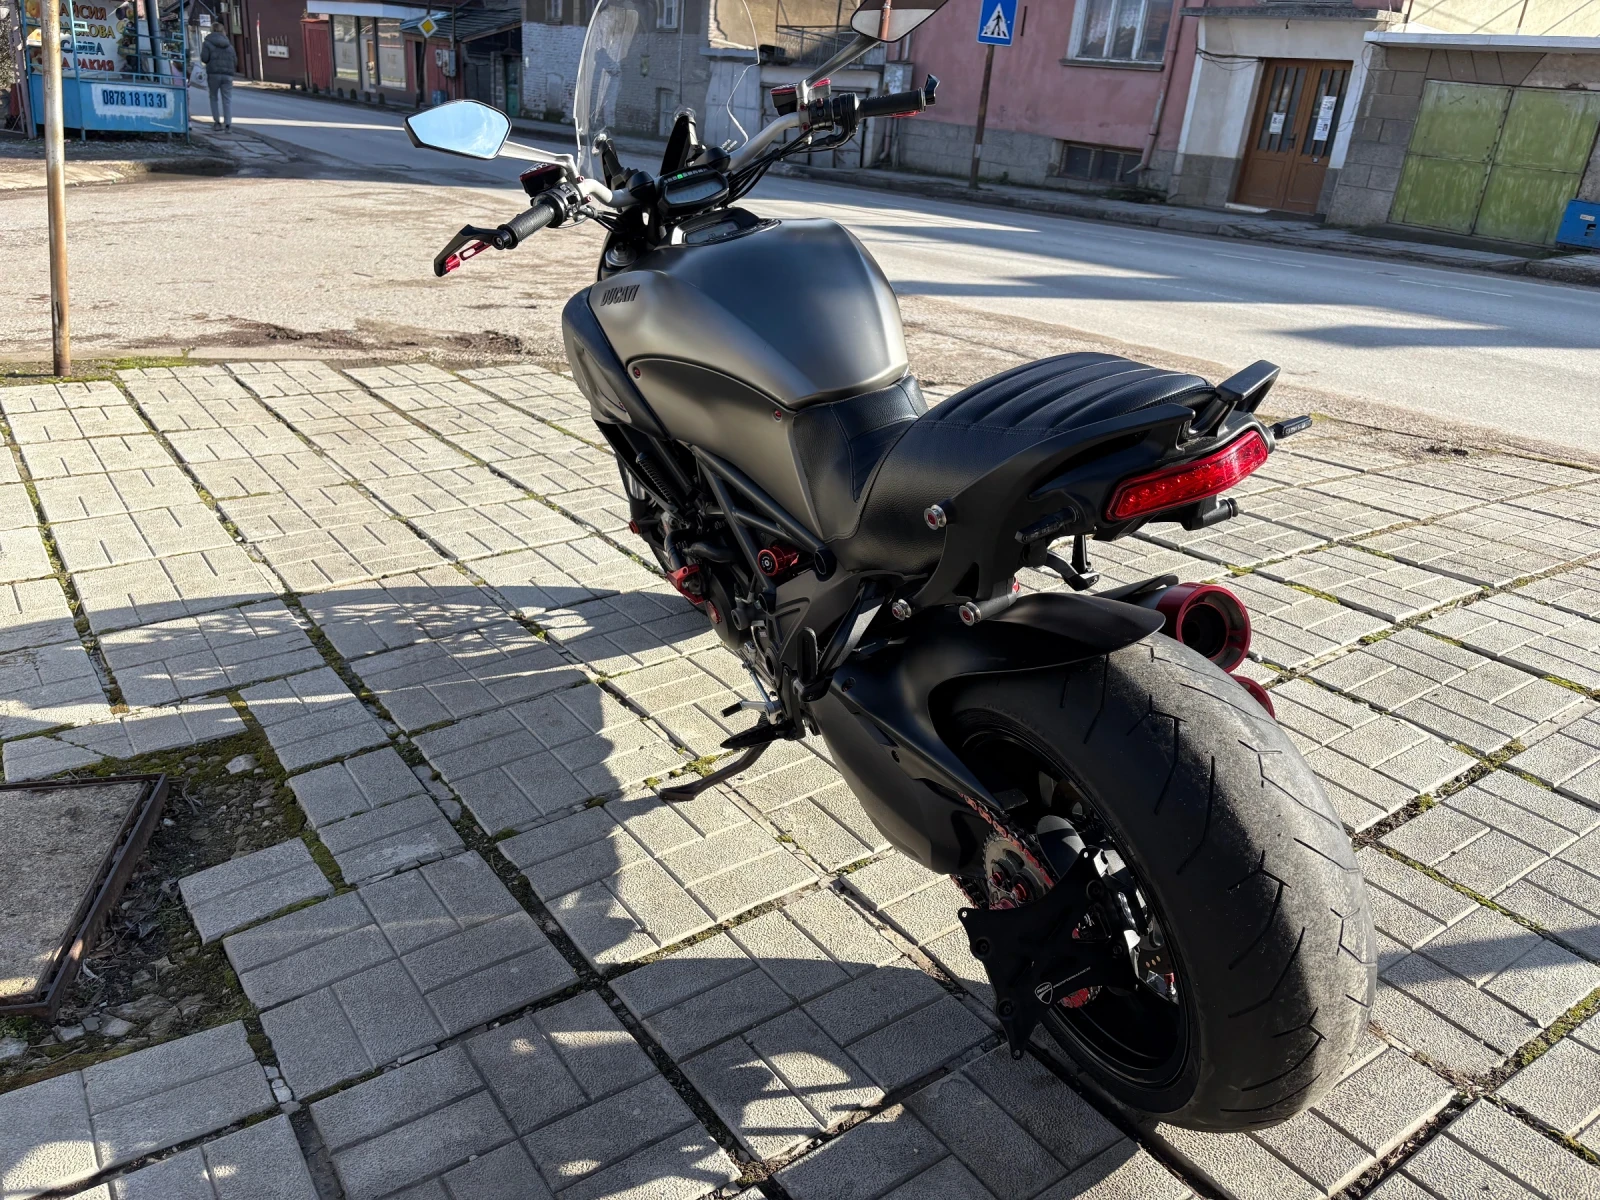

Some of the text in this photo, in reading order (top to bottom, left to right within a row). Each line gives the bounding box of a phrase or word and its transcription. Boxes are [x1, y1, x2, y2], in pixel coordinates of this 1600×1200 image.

[60, 2, 107, 21] АЙСИЯ
[61, 57, 71, 71] А
[102, 90, 167, 108] 0878 18 13 31
[600, 284, 640, 306] DUCATI
